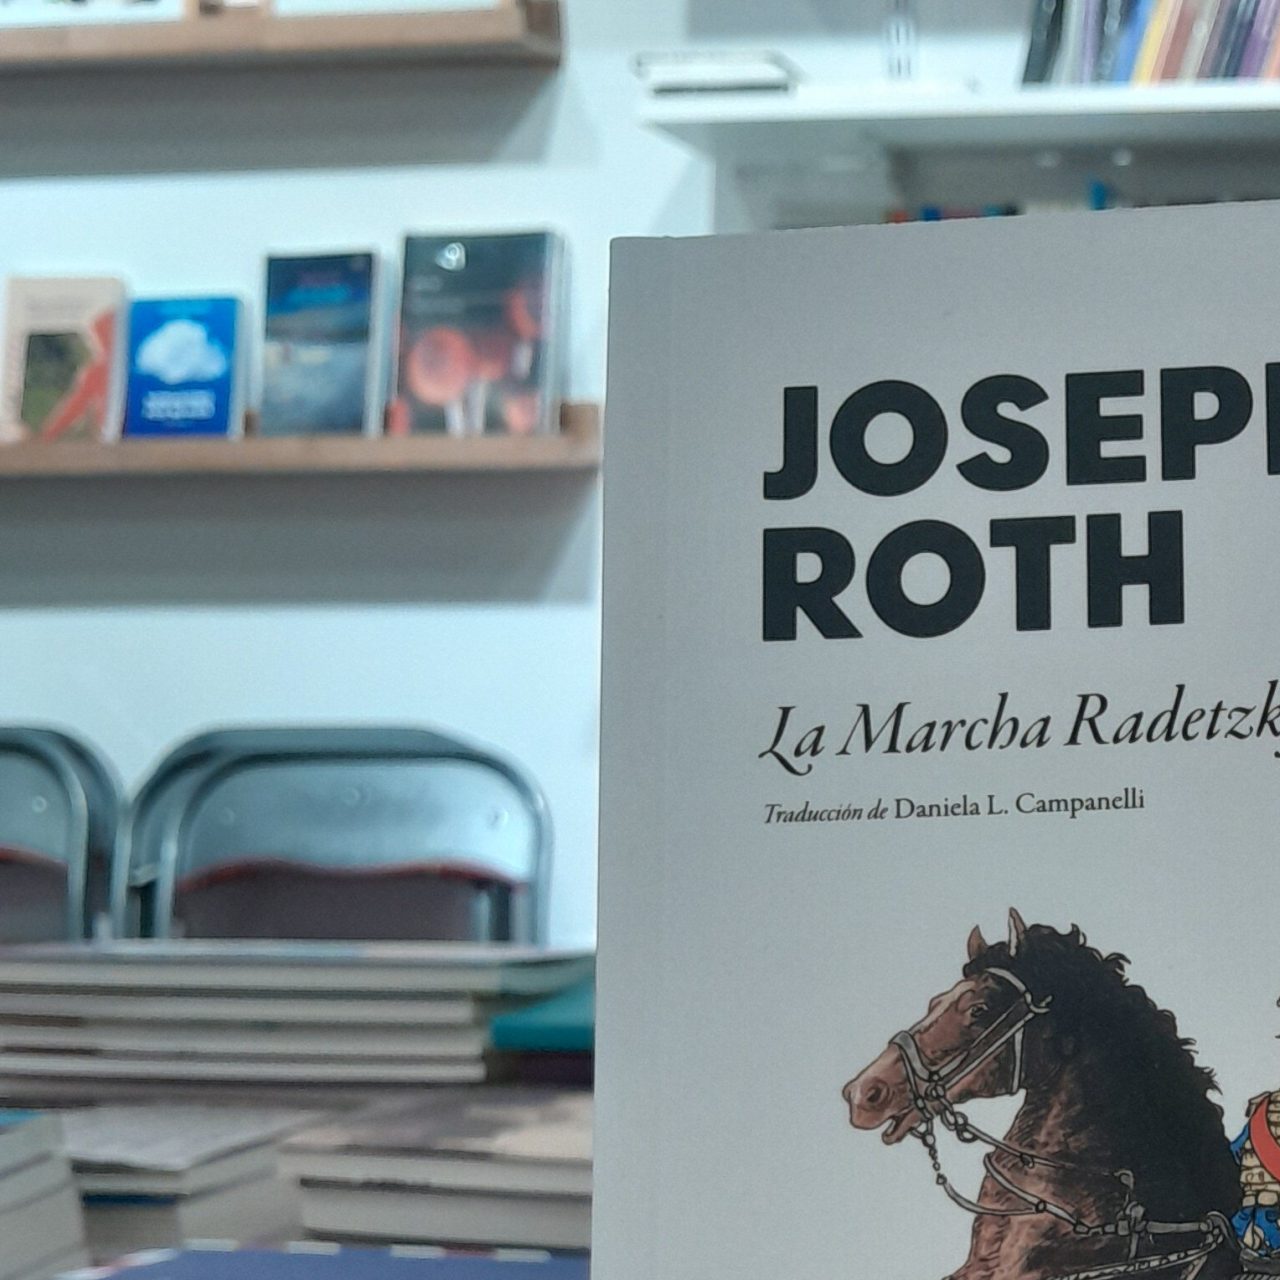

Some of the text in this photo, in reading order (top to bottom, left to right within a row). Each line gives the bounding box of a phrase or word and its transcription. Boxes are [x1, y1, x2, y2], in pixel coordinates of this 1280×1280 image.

[761, 509, 1186, 643] ROTH
[758, 703, 827, 777] La
[836, 692, 1052, 756] Marcha
[765, 787, 1146, 824] Traducción de Daniela L. Campanelli
